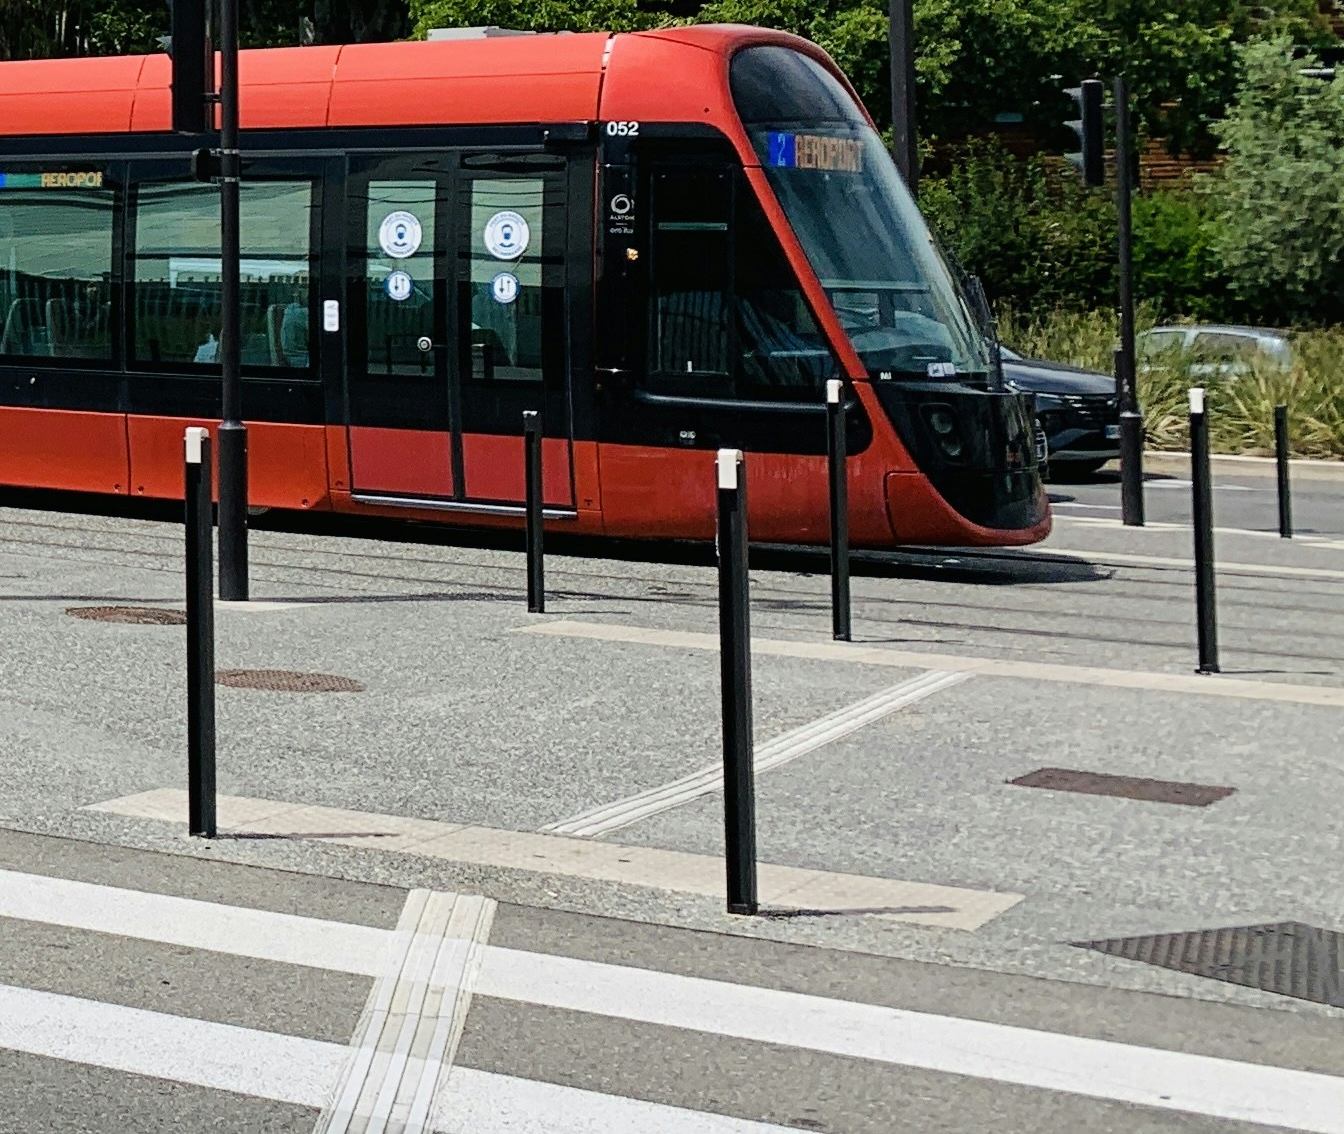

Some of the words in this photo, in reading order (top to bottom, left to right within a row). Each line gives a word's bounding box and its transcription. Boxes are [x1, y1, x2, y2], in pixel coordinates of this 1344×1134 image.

[606, 120, 640, 137] 052
[777, 133, 786, 167] 2
[795, 134, 864, 173] AEROPORT
